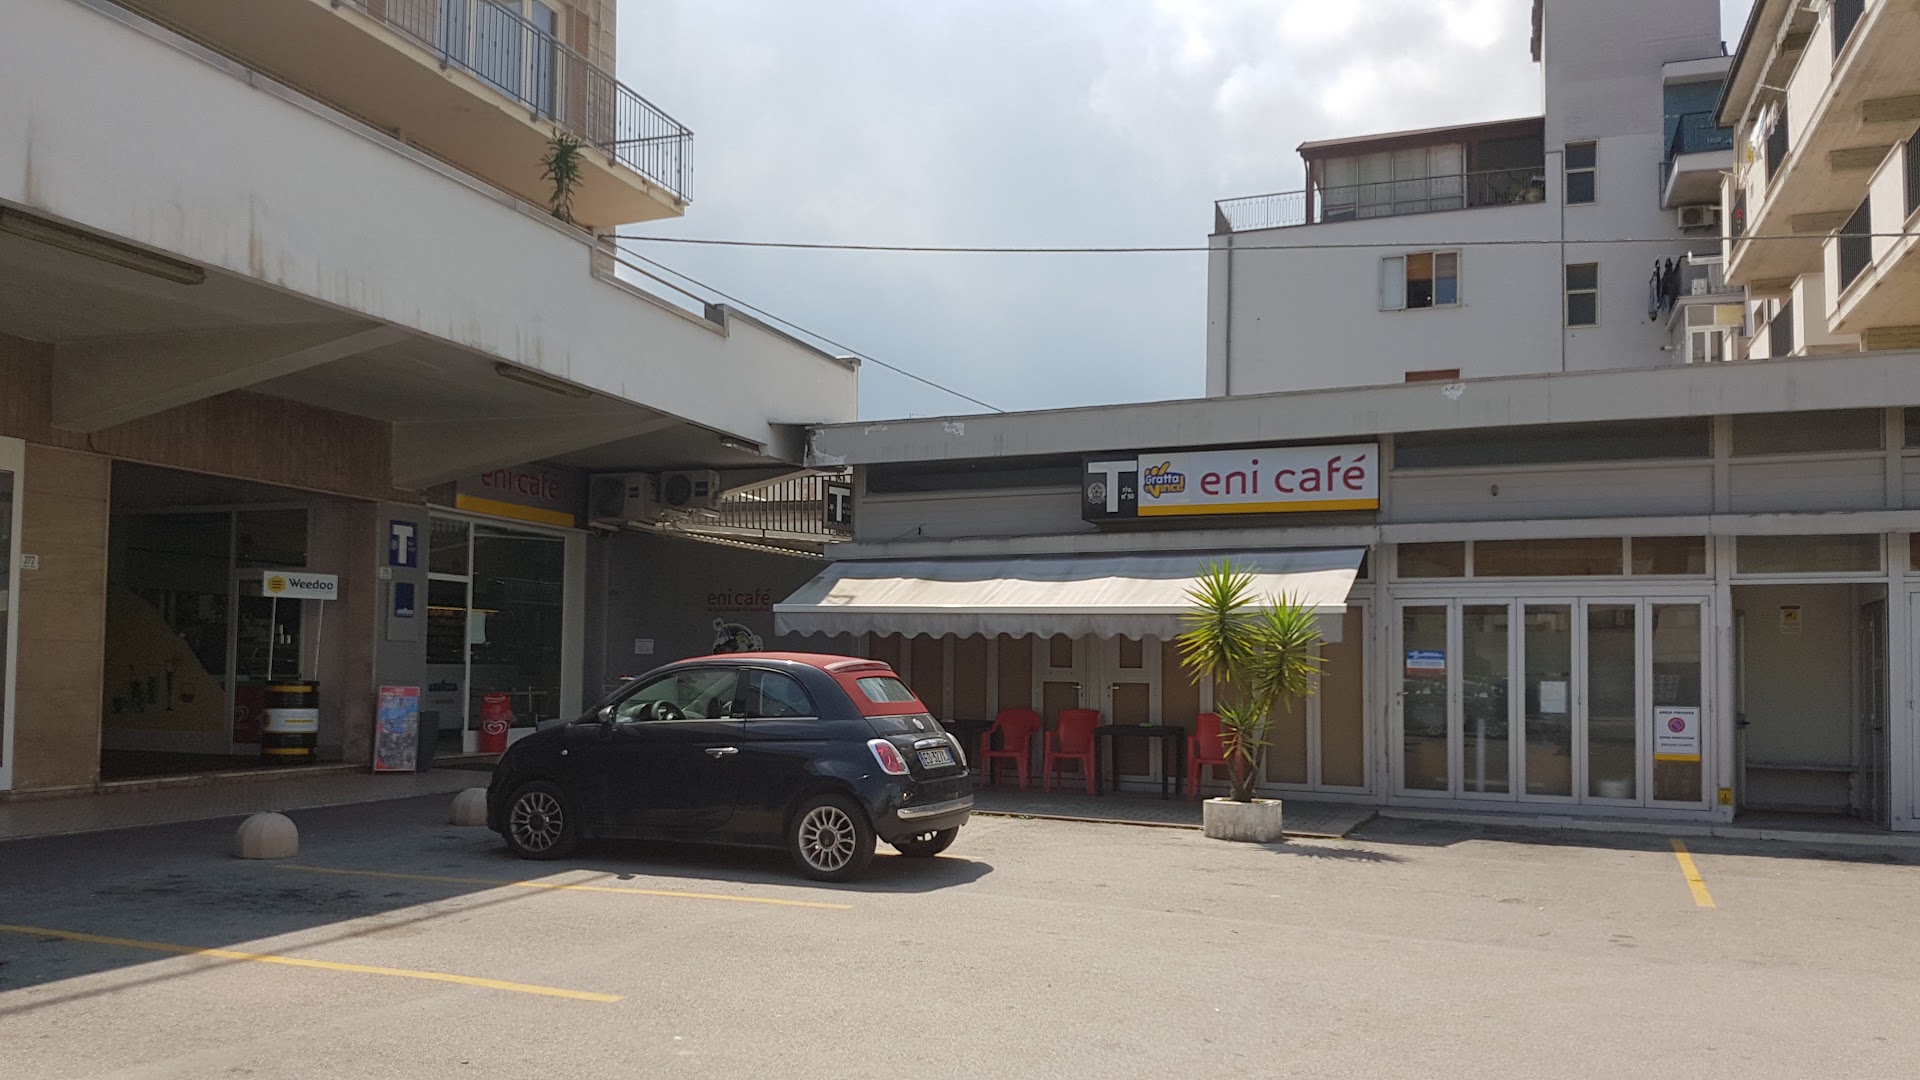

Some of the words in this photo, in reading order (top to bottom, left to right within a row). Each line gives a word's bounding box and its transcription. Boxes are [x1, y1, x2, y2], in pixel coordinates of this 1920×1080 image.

[1088, 460, 1138, 513] T
[1145, 474, 1180, 485] Gratta
[1200, 459, 1259, 496] eni
[1275, 454, 1366, 493] café
[829, 486, 851, 522] T
[393, 524, 414, 564] T
[289, 578, 335, 590] Weedoo
[708, 588, 732, 606] eni
[735, 588, 771, 606] café
